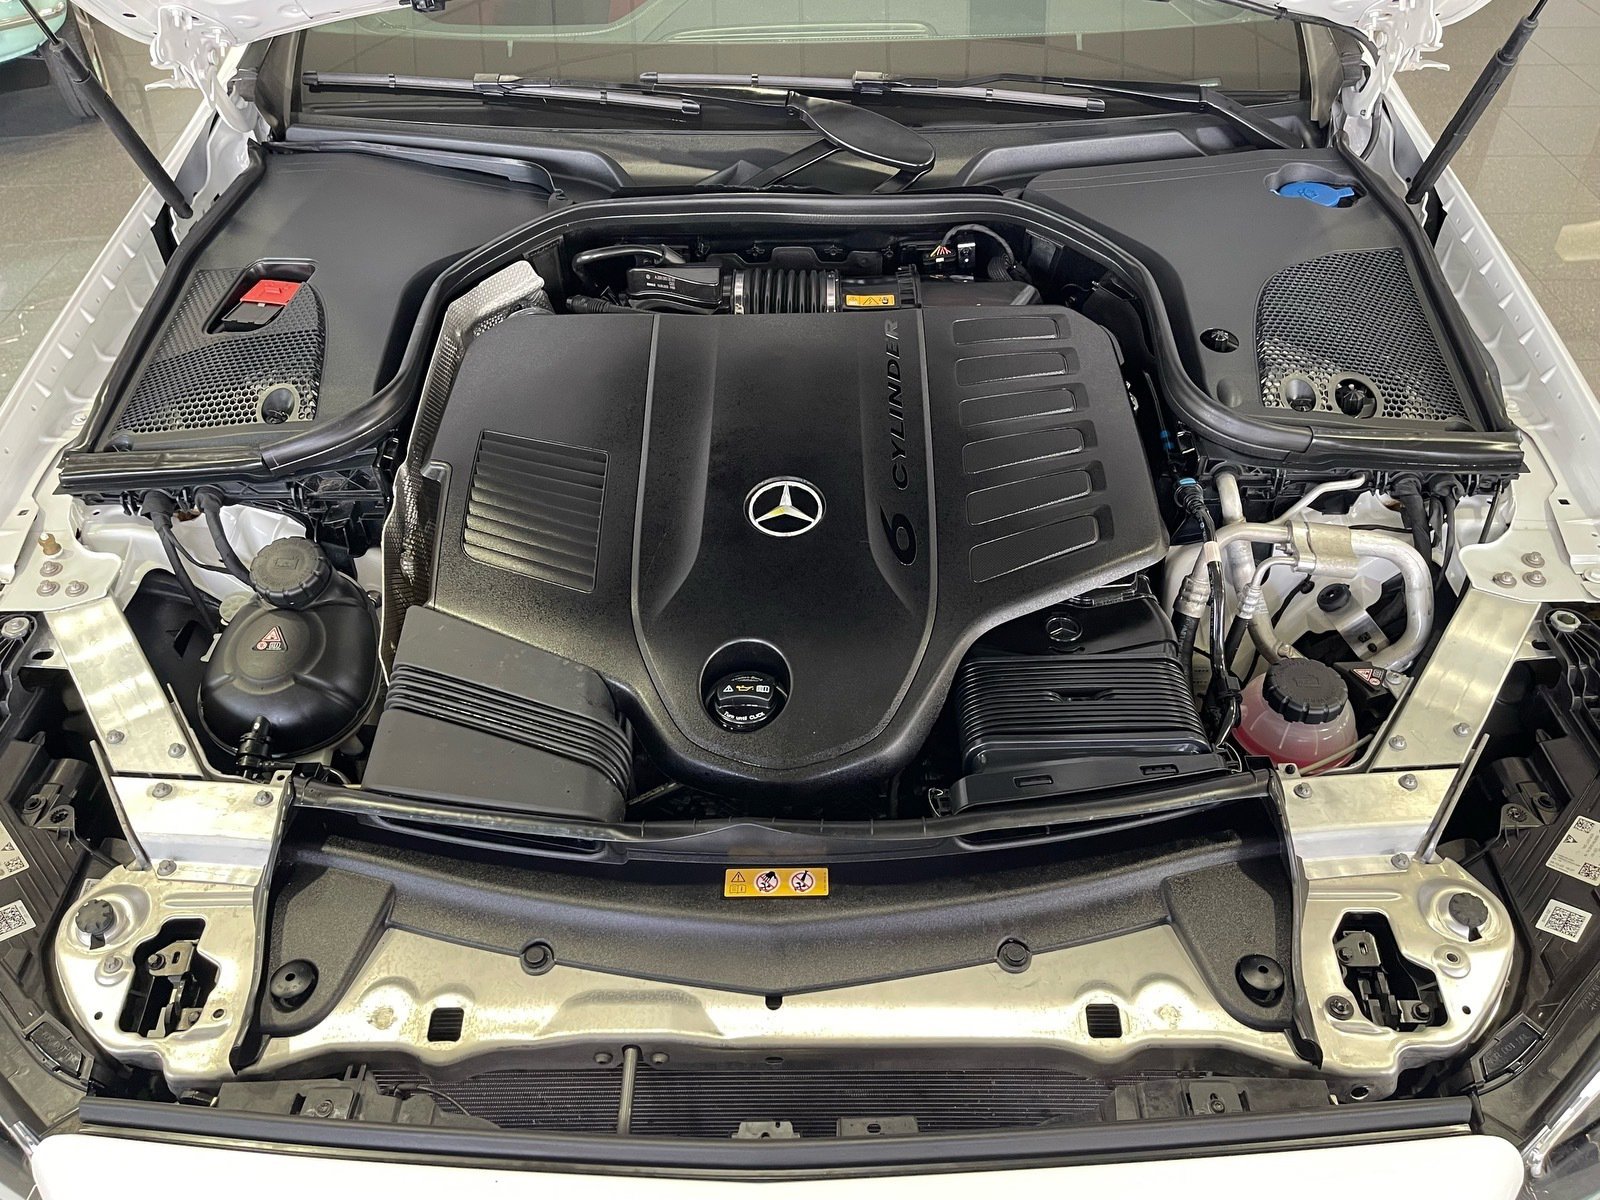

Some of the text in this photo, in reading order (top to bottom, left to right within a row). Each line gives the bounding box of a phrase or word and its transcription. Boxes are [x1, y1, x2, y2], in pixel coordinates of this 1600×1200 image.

[880, 318, 917, 566] 6 CYLINDER
[749, 712, 765, 720] CLICK
